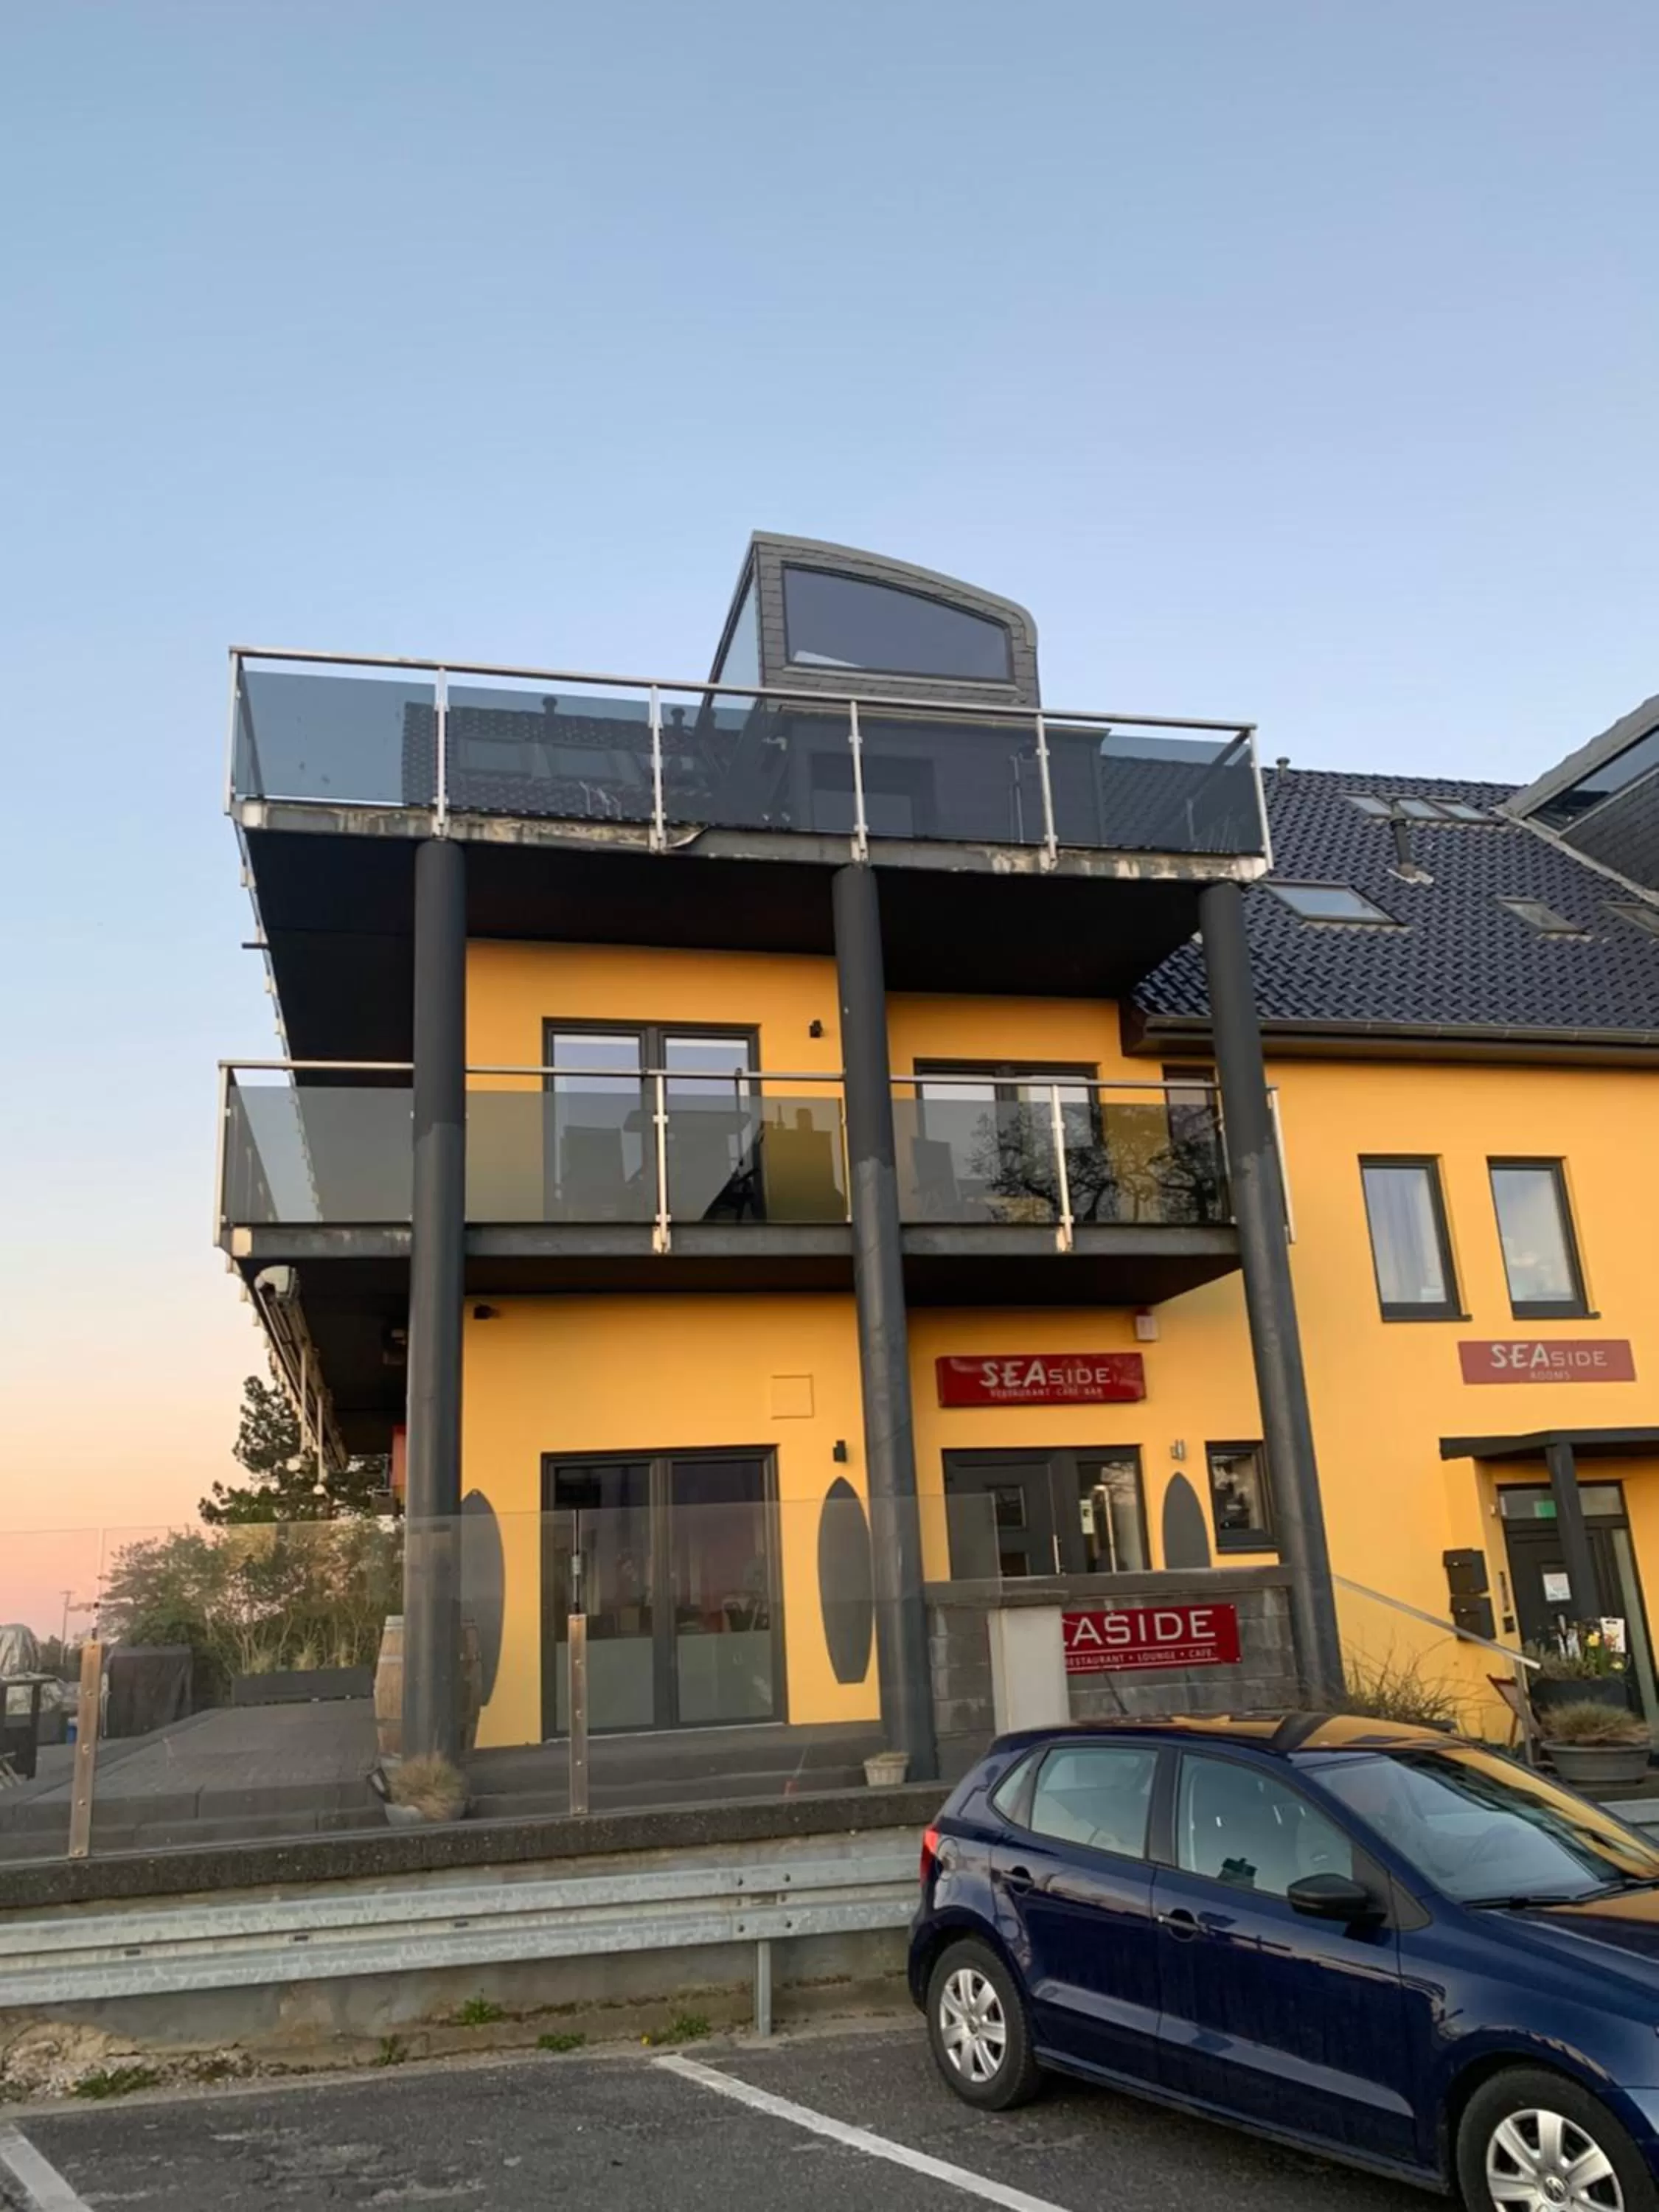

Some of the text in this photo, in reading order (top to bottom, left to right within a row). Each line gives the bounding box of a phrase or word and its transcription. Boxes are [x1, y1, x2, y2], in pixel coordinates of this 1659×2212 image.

[1063, 1610, 1216, 1647] ASIDE
[1066, 1654, 1124, 1666] ESTAURANT
[1138, 1651, 1176, 1663] LOUNGE
